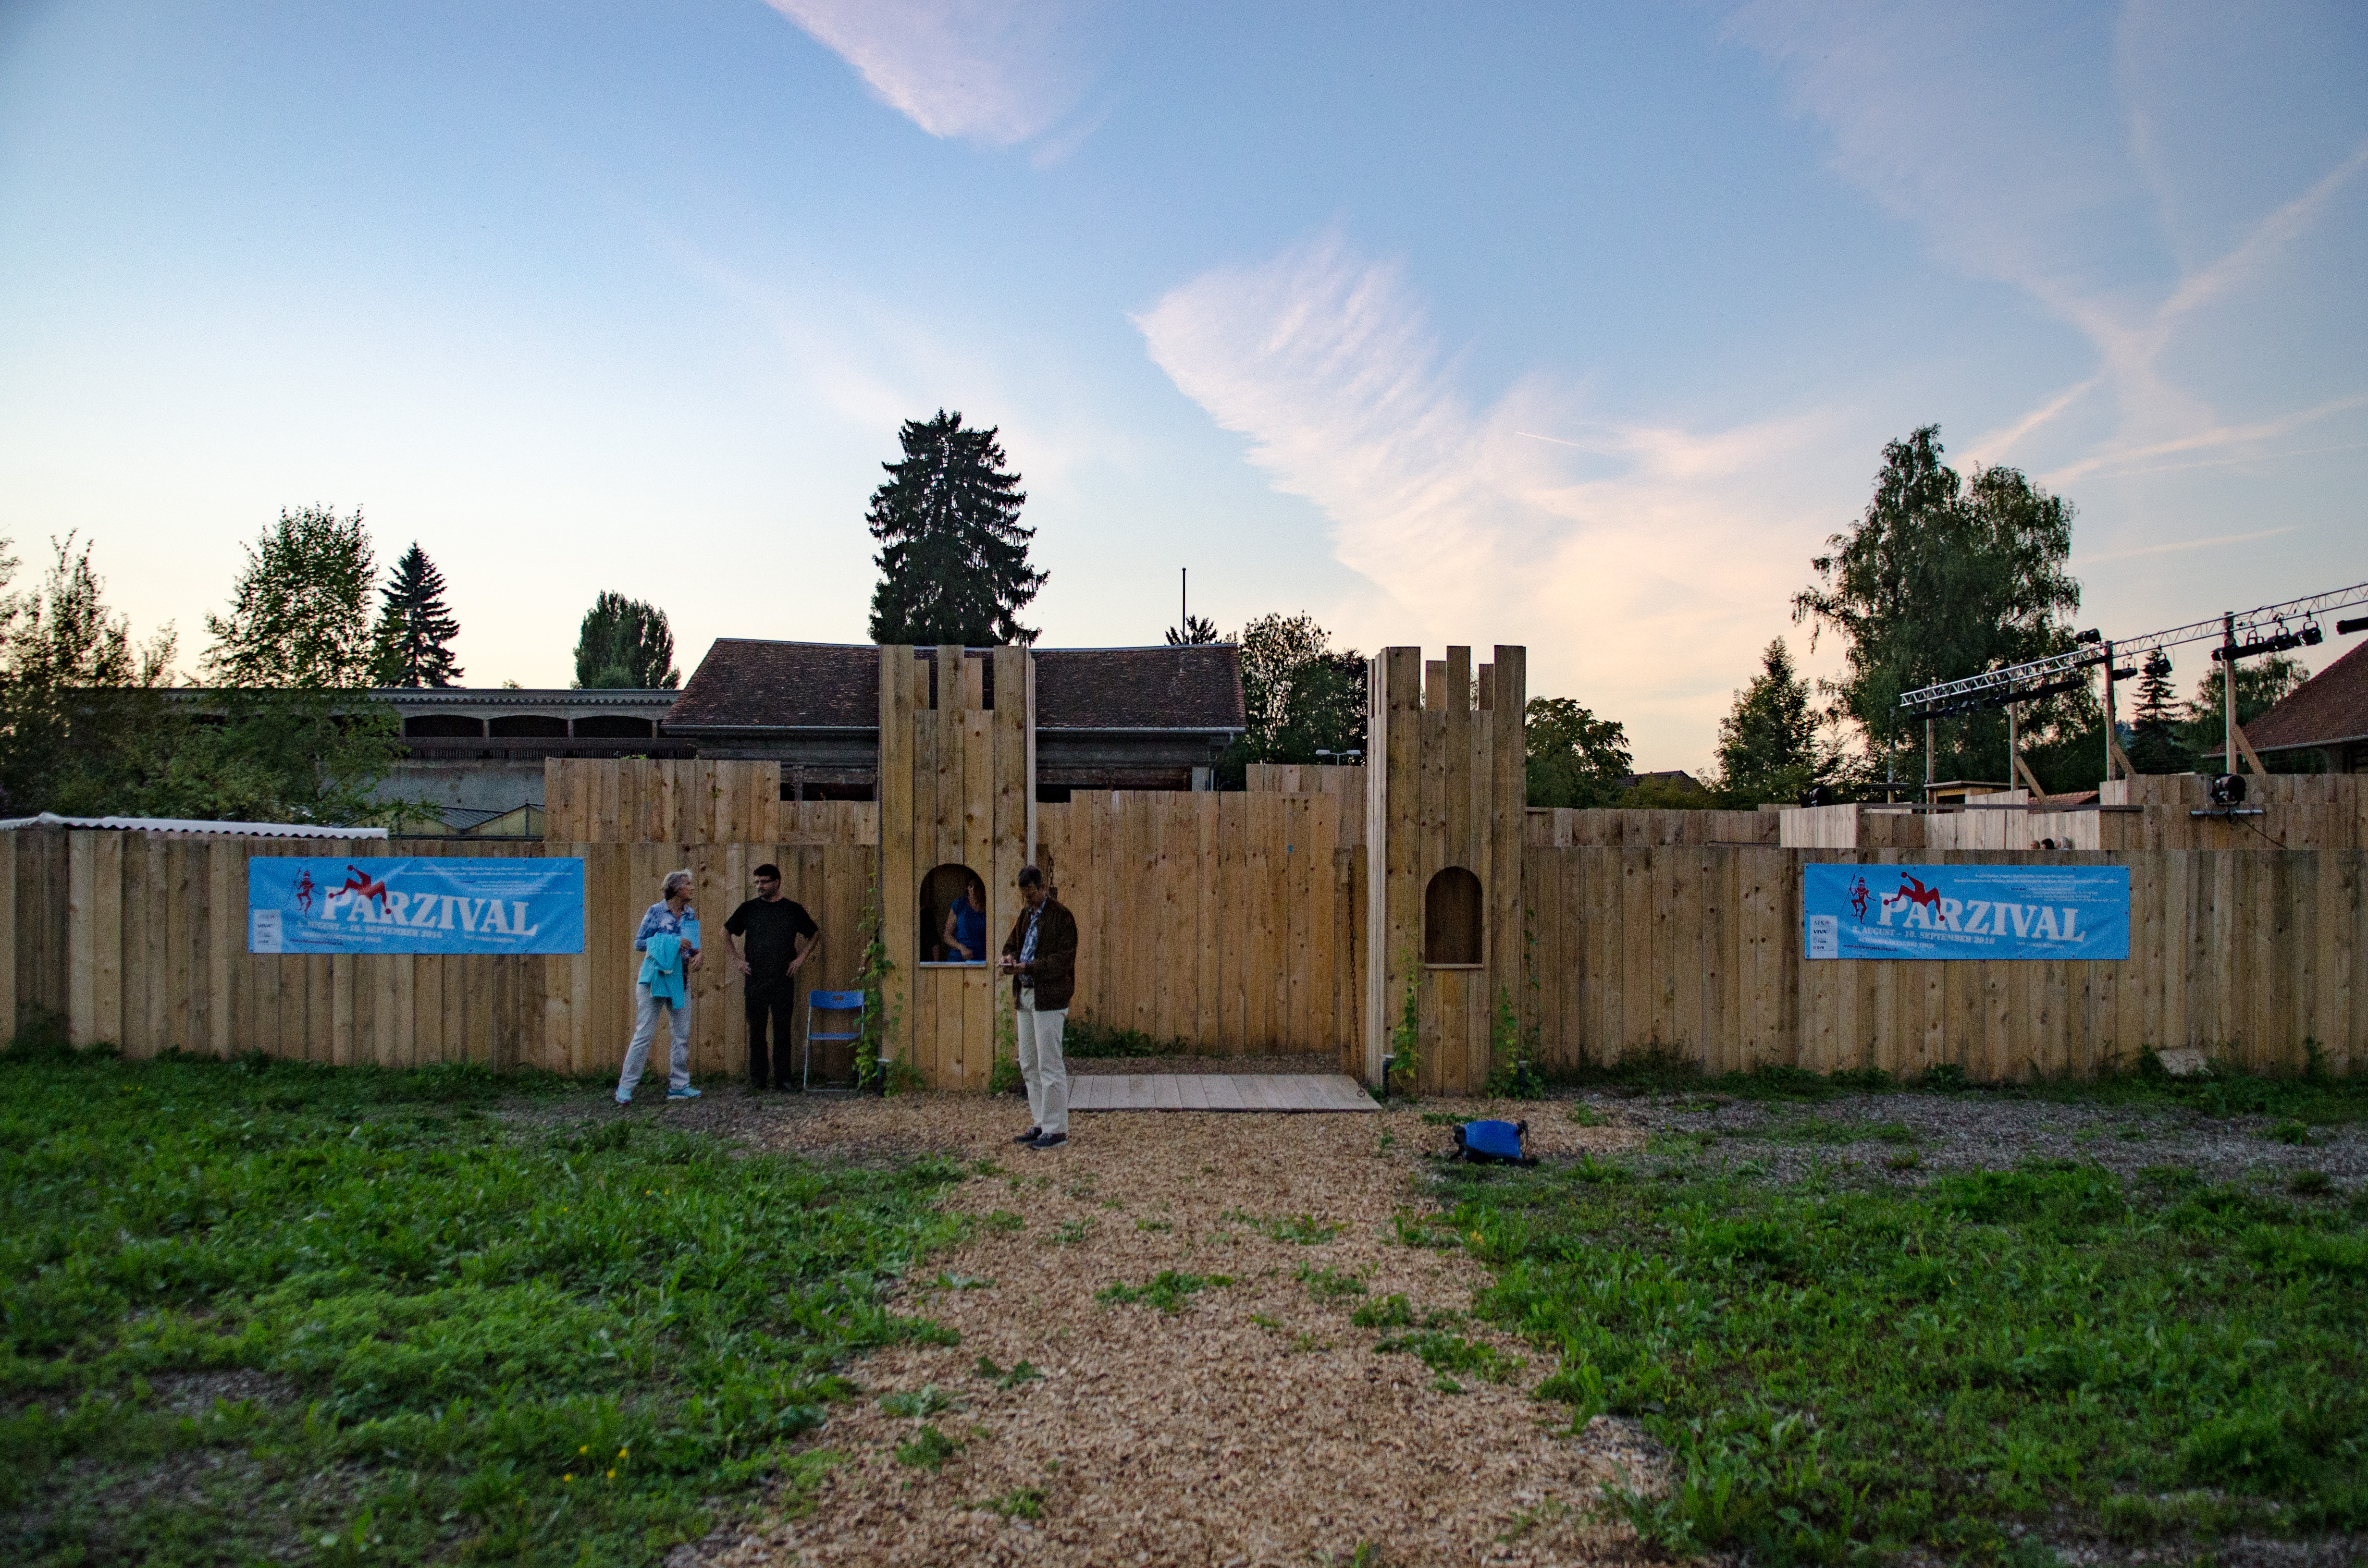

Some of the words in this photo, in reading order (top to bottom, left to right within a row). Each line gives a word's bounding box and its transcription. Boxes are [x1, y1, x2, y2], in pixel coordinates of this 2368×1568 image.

[321, 886, 539, 936] PARZIVAL
[1862, 927, 1895, 936] AUGUST
[1920, 931, 1972, 943] SEPTEMBER
[1876, 892, 2086, 942] PARZIVAL
